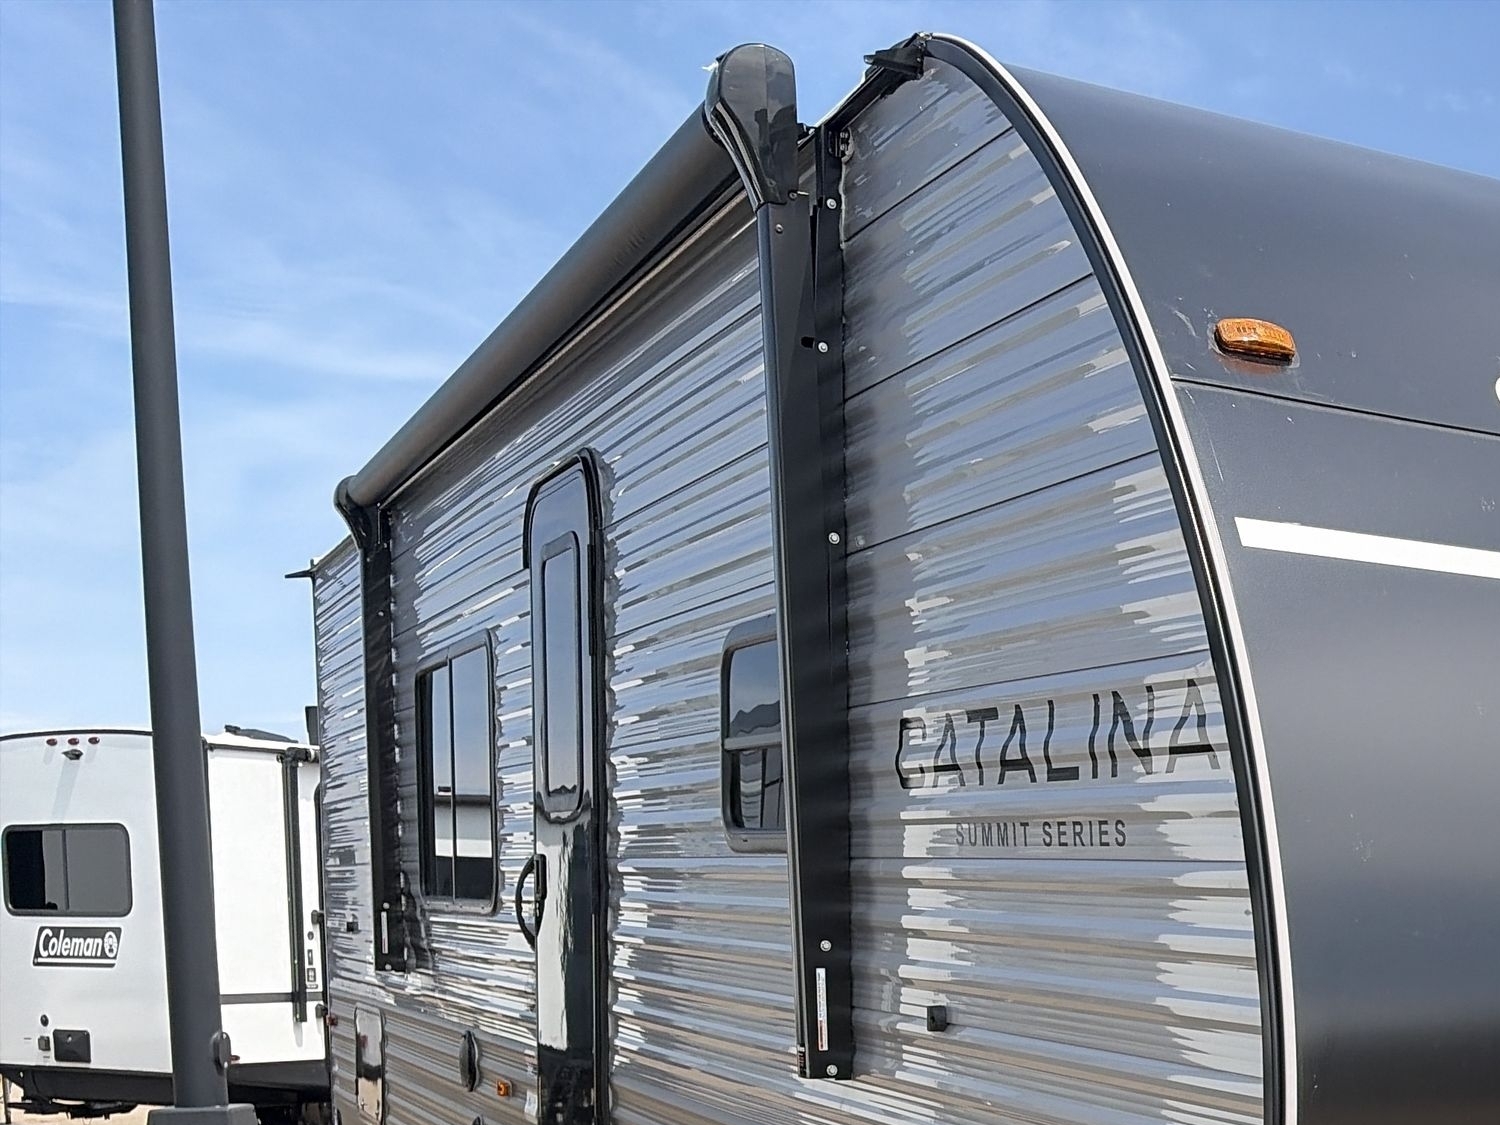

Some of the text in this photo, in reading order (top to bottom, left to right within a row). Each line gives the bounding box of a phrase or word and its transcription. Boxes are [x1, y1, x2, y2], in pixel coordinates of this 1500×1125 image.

[895, 678, 1221, 790] CATALINA
[955, 818, 1128, 848] SUMMIT SERIES
[38, 928, 103, 958] Coleman
